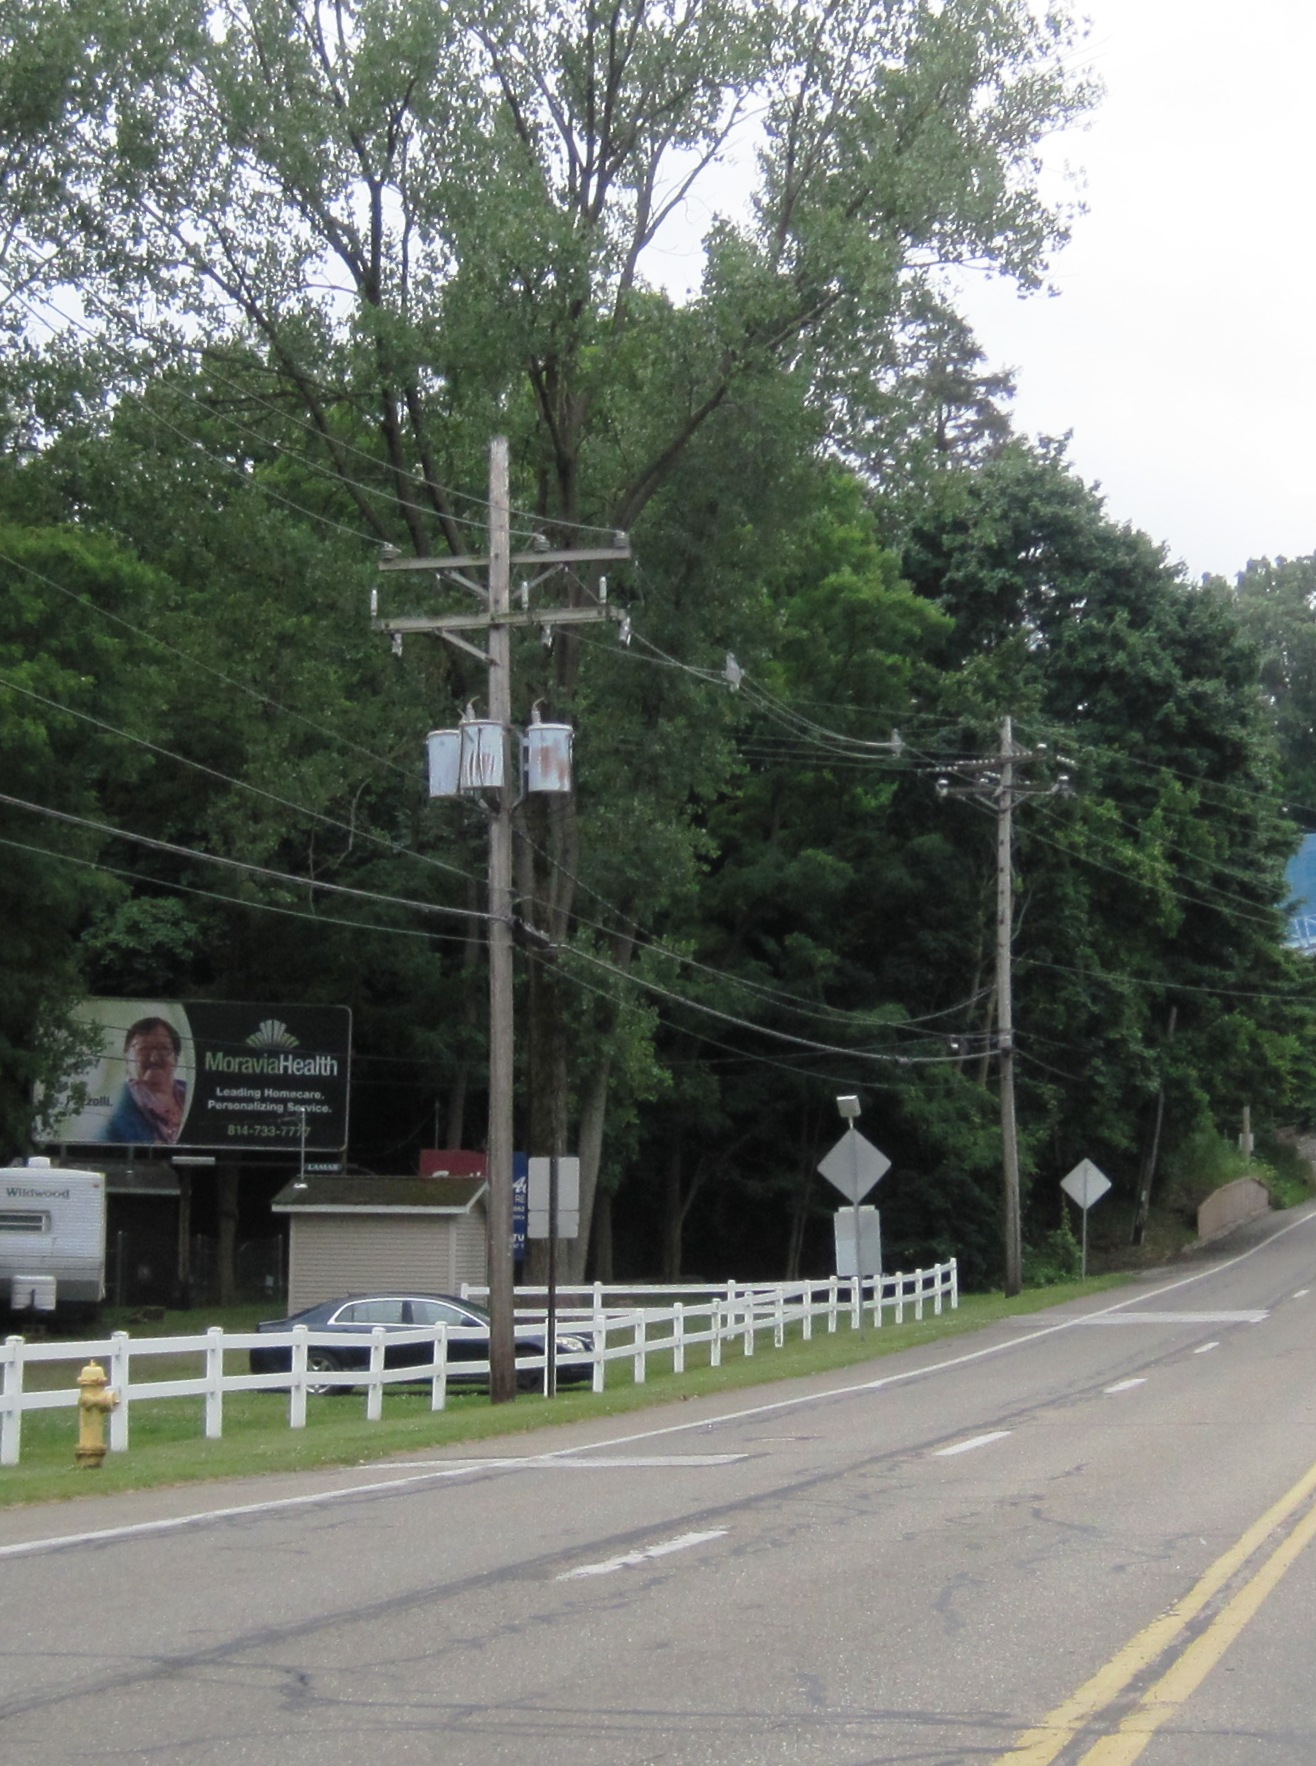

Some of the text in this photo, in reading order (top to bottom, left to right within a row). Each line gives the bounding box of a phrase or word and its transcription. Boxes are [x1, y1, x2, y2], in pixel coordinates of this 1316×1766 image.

[205, 1051, 337, 1076] MoraviaHealth
[216, 1087, 325, 1099] Leading Homecare.
[208, 1100, 332, 1113] Personalizing Service.
[6, 1187, 70, 1199] Wildwood
